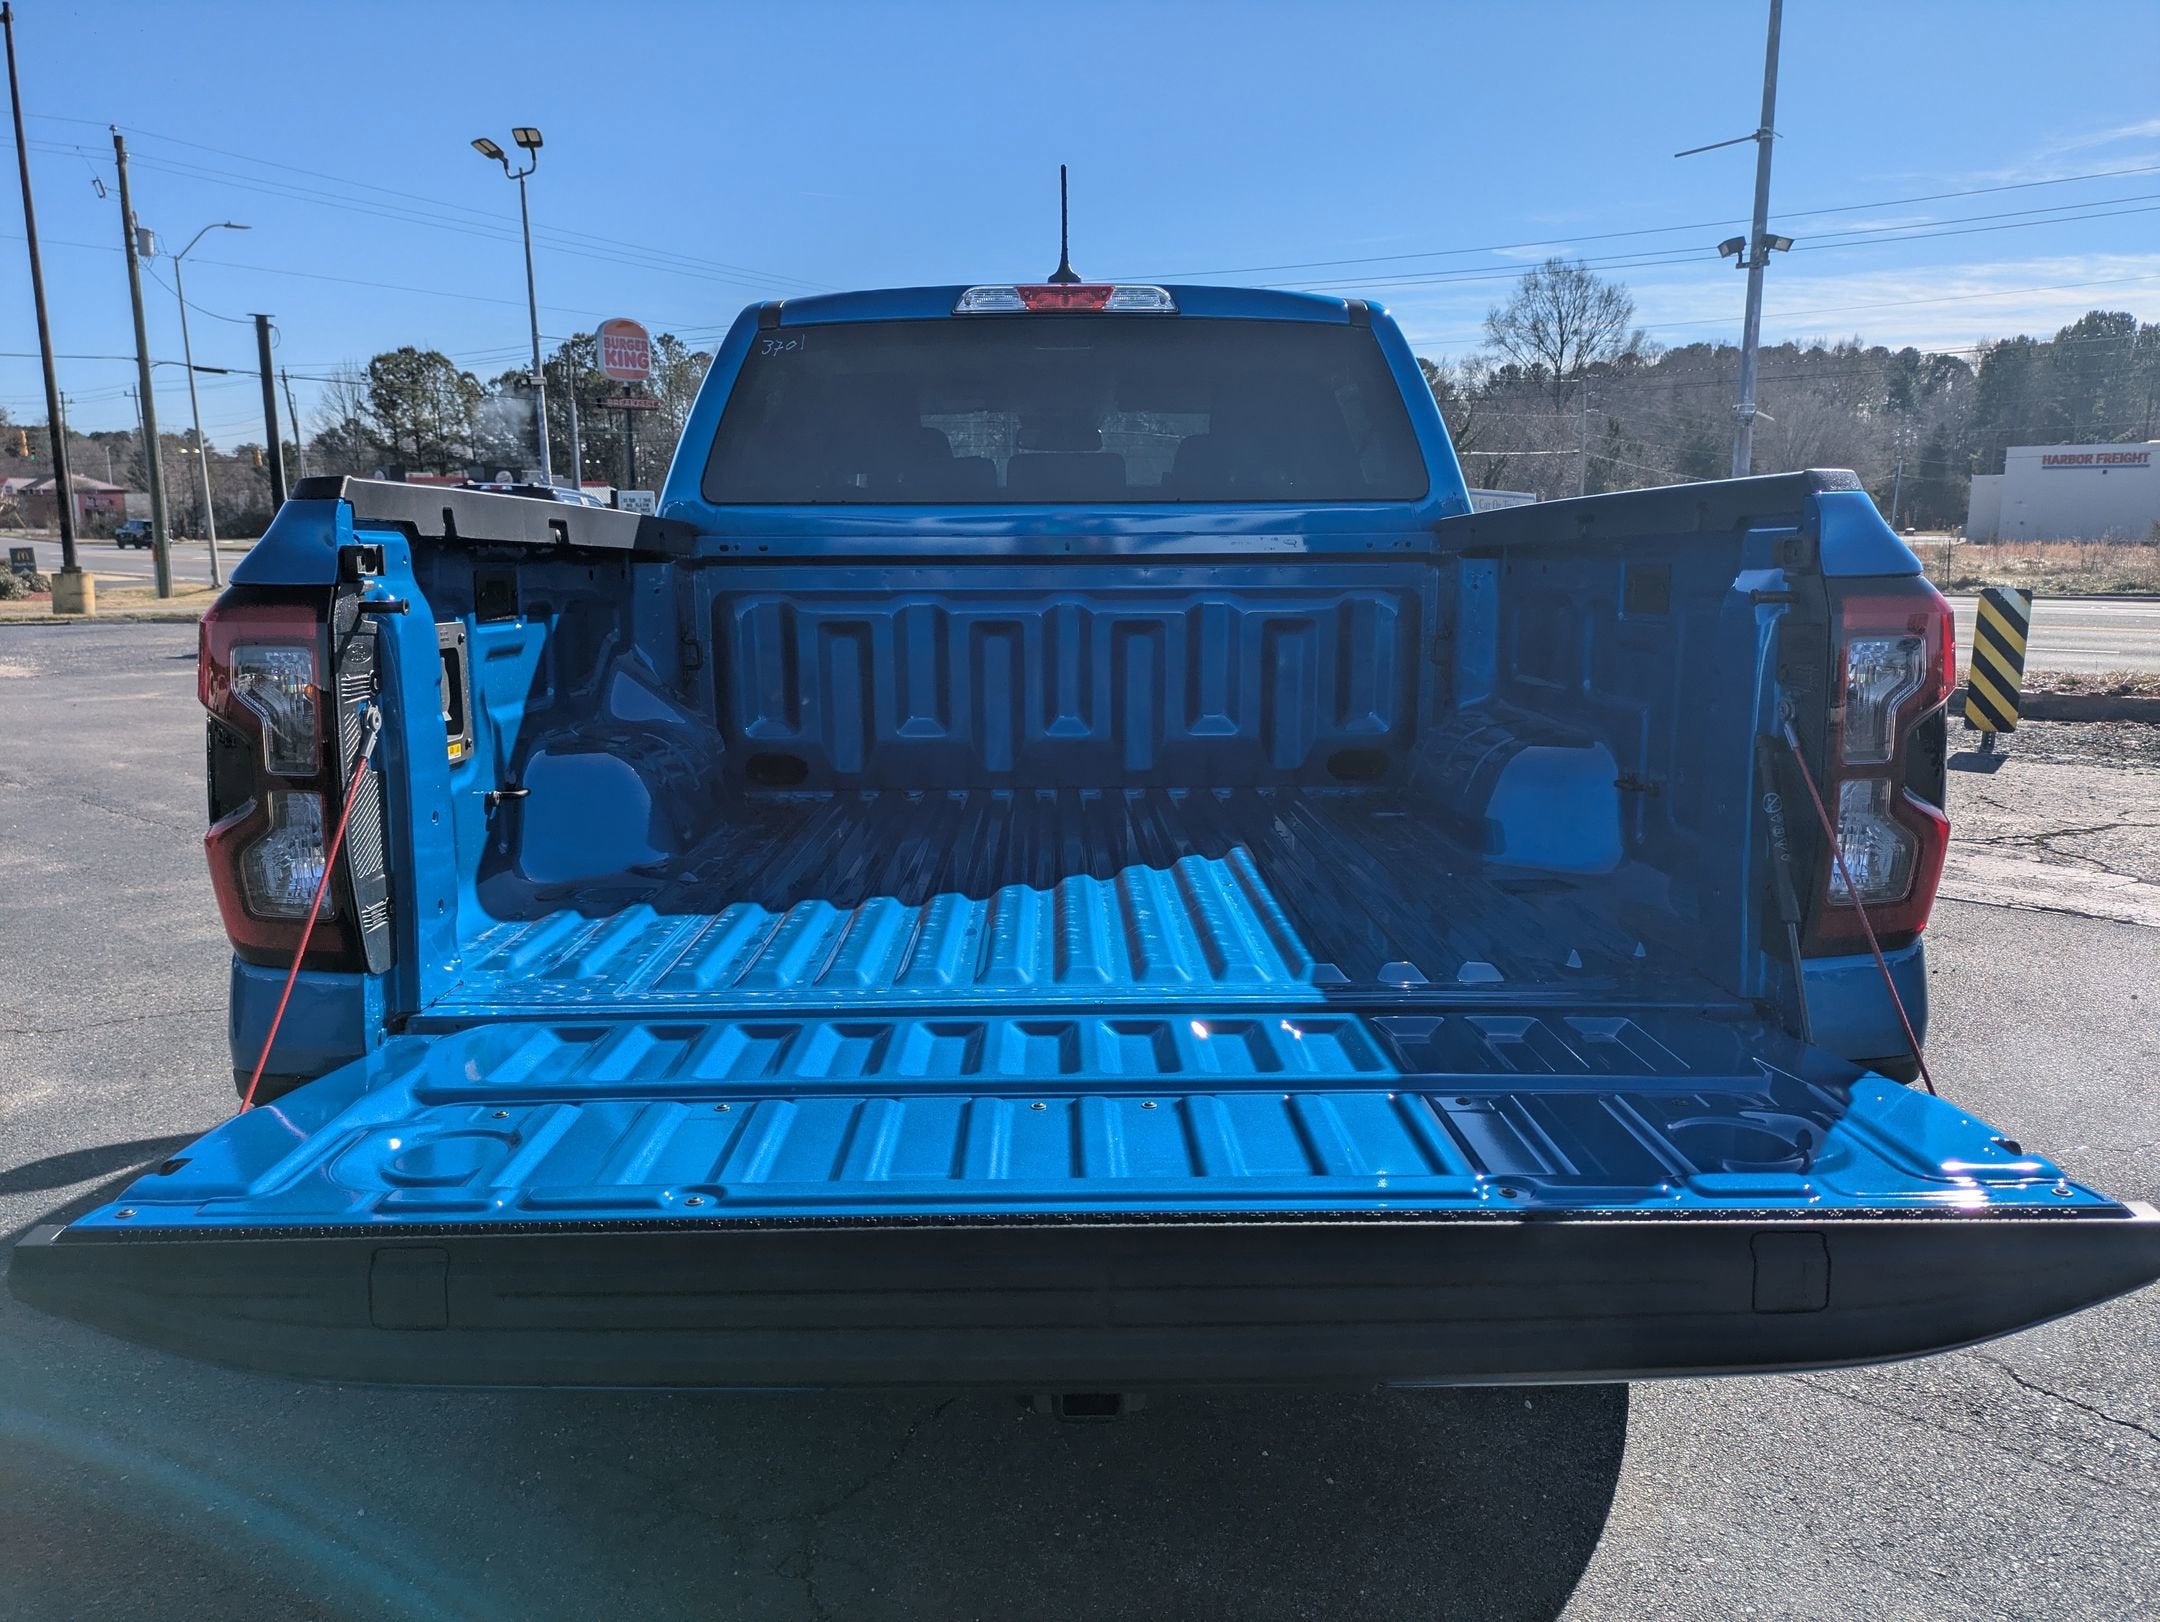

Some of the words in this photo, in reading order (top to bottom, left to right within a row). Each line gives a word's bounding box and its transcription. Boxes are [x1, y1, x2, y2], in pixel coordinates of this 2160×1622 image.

[604, 336, 649, 352] BURGER
[761, 334, 806, 357] 3701
[604, 350, 649, 369] KING
[2042, 454, 2094, 465] HARBOR
[2096, 452, 2152, 464] FREIGHT
